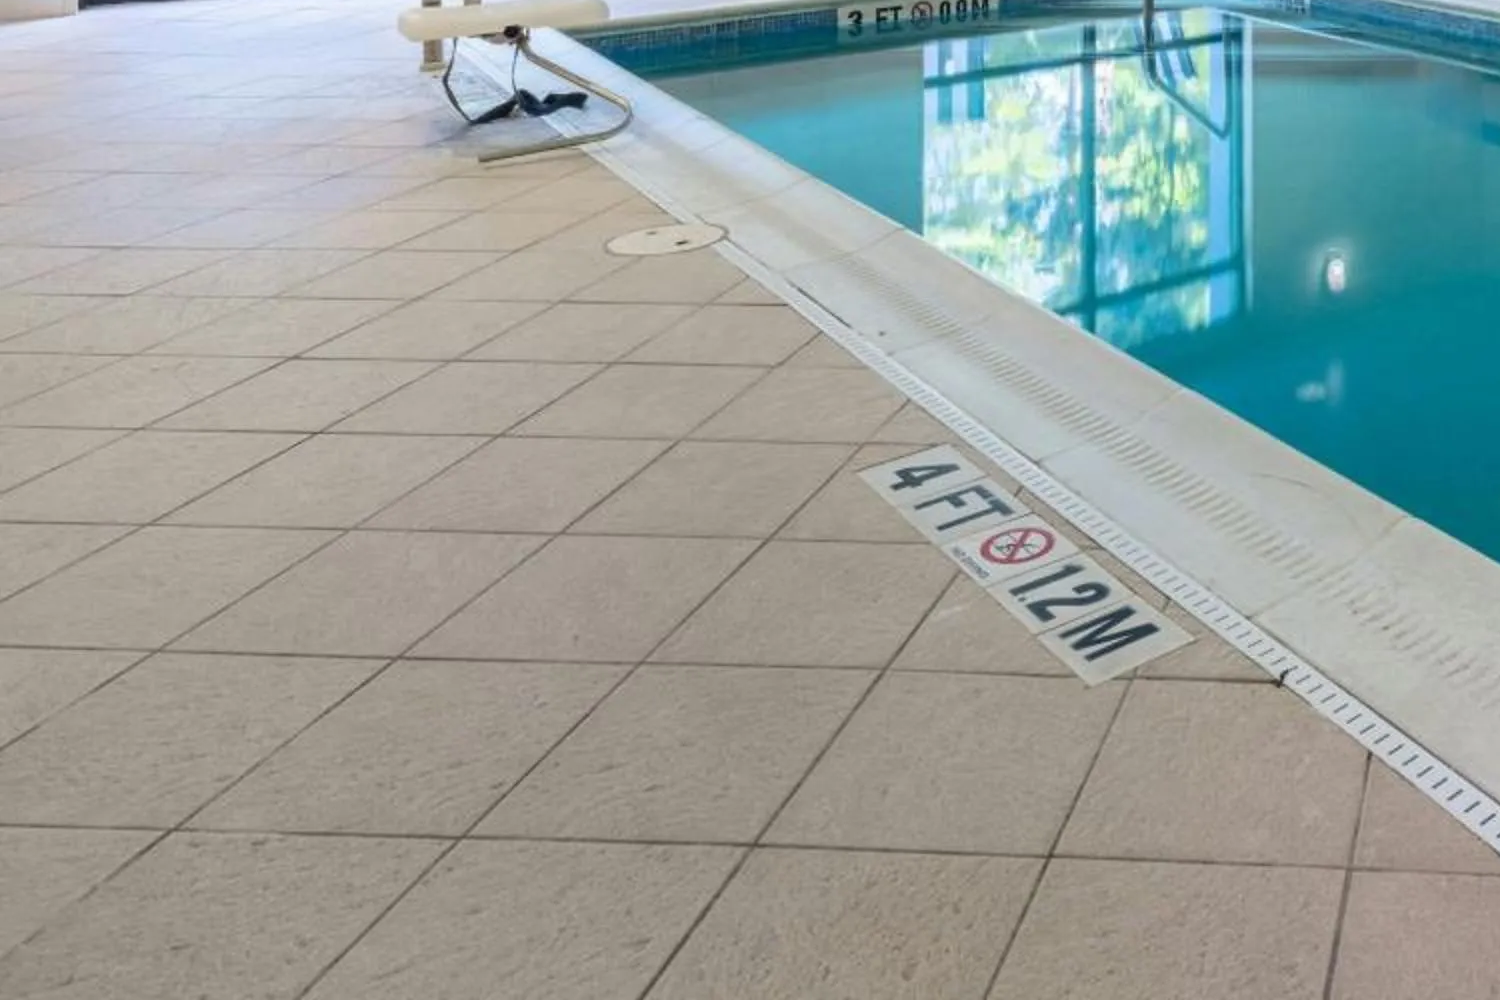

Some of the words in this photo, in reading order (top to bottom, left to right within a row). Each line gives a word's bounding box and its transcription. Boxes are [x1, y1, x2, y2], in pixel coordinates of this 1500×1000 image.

[848, 10, 863, 34] 3
[876, 6, 903, 28] FT
[890, 462, 961, 492] 4
[913, 484, 1015, 532] FT
